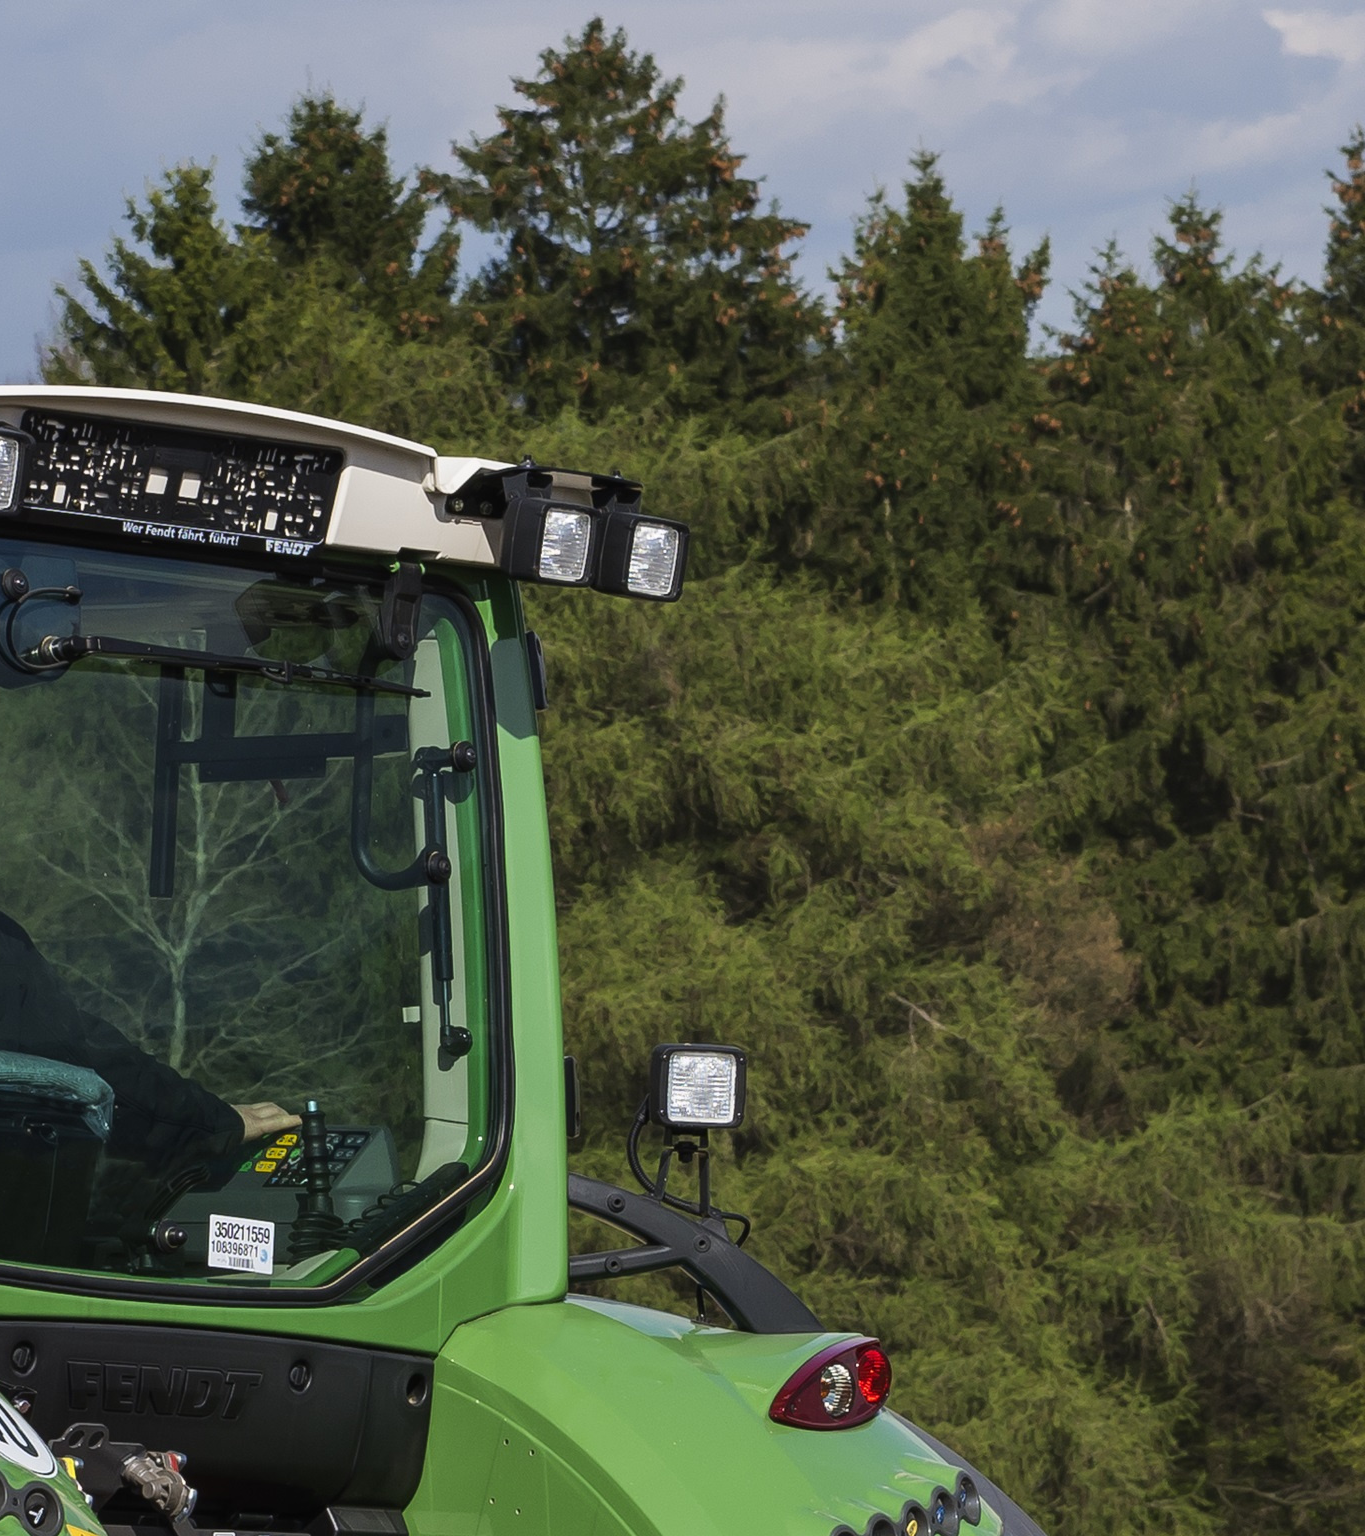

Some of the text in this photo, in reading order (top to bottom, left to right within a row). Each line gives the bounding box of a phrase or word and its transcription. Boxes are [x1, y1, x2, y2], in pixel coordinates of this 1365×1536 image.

[122, 521, 239, 546] Wer Fendt fährt, führt!
[265, 539, 314, 556] FENDT
[214, 1221, 270, 1244] 350211559
[211, 1240, 258, 1258] 108396871
[66, 1359, 263, 1420] FENDT
